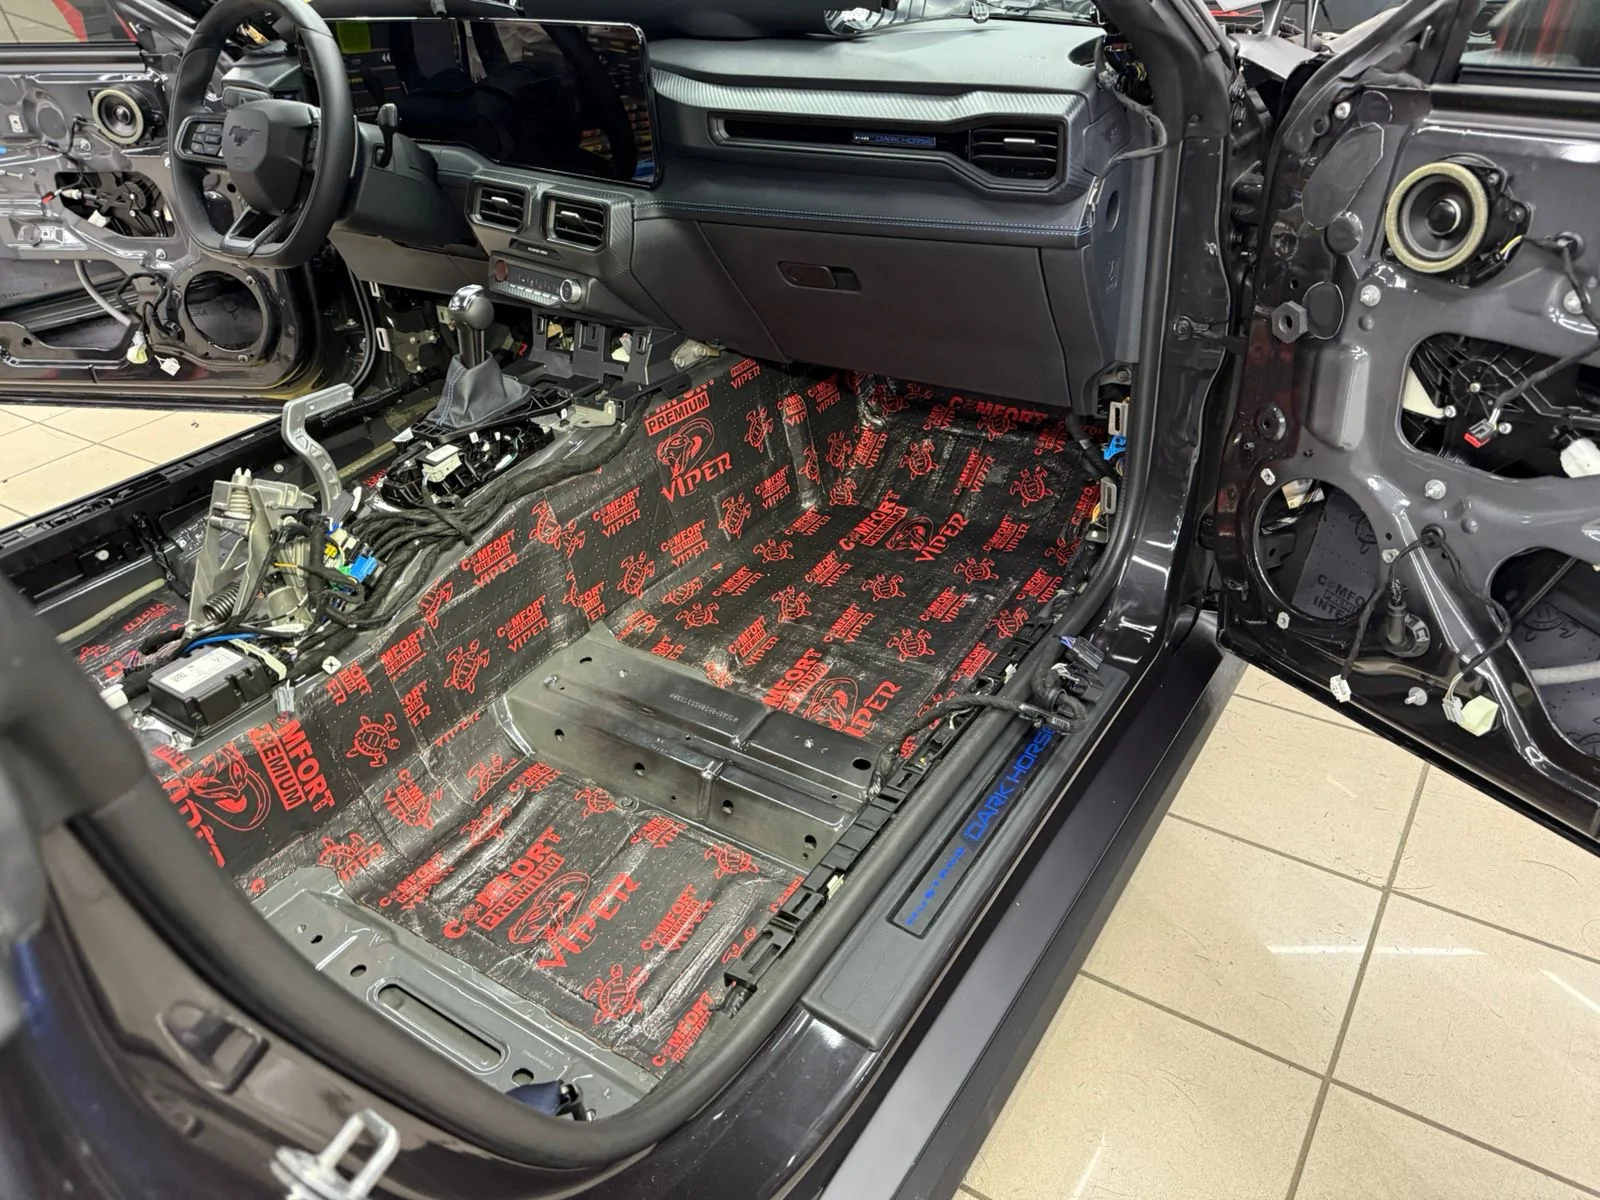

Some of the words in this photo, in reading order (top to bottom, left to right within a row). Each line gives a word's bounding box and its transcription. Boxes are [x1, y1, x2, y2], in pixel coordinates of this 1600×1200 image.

[644, 391, 710, 437] PREMIUM
[661, 452, 733, 502] VIPER
[762, 484, 791, 510] VIPER
[601, 509, 641, 538] VIPER
[861, 505, 908, 547] PREMIUM
[914, 511, 969, 561] VIPER
[1003, 523, 1030, 552] VIPER
[473, 544, 511, 575] PREMIUM
[473, 553, 519, 589] VIPER
[672, 541, 710, 568] VIPER
[731, 572, 764, 596] VIPER
[822, 563, 853, 588] VIPER
[508, 609, 543, 641] PREMIUM
[508, 617, 550, 652] VIPER
[844, 612, 876, 643] VIPER
[744, 636, 779, 665] VIPER
[962, 784, 1013, 841] DARK
[476, 850, 566, 931] PREMIUM
[536, 872, 641, 969] VIPER
[658, 899, 701, 946] PREMIUM
